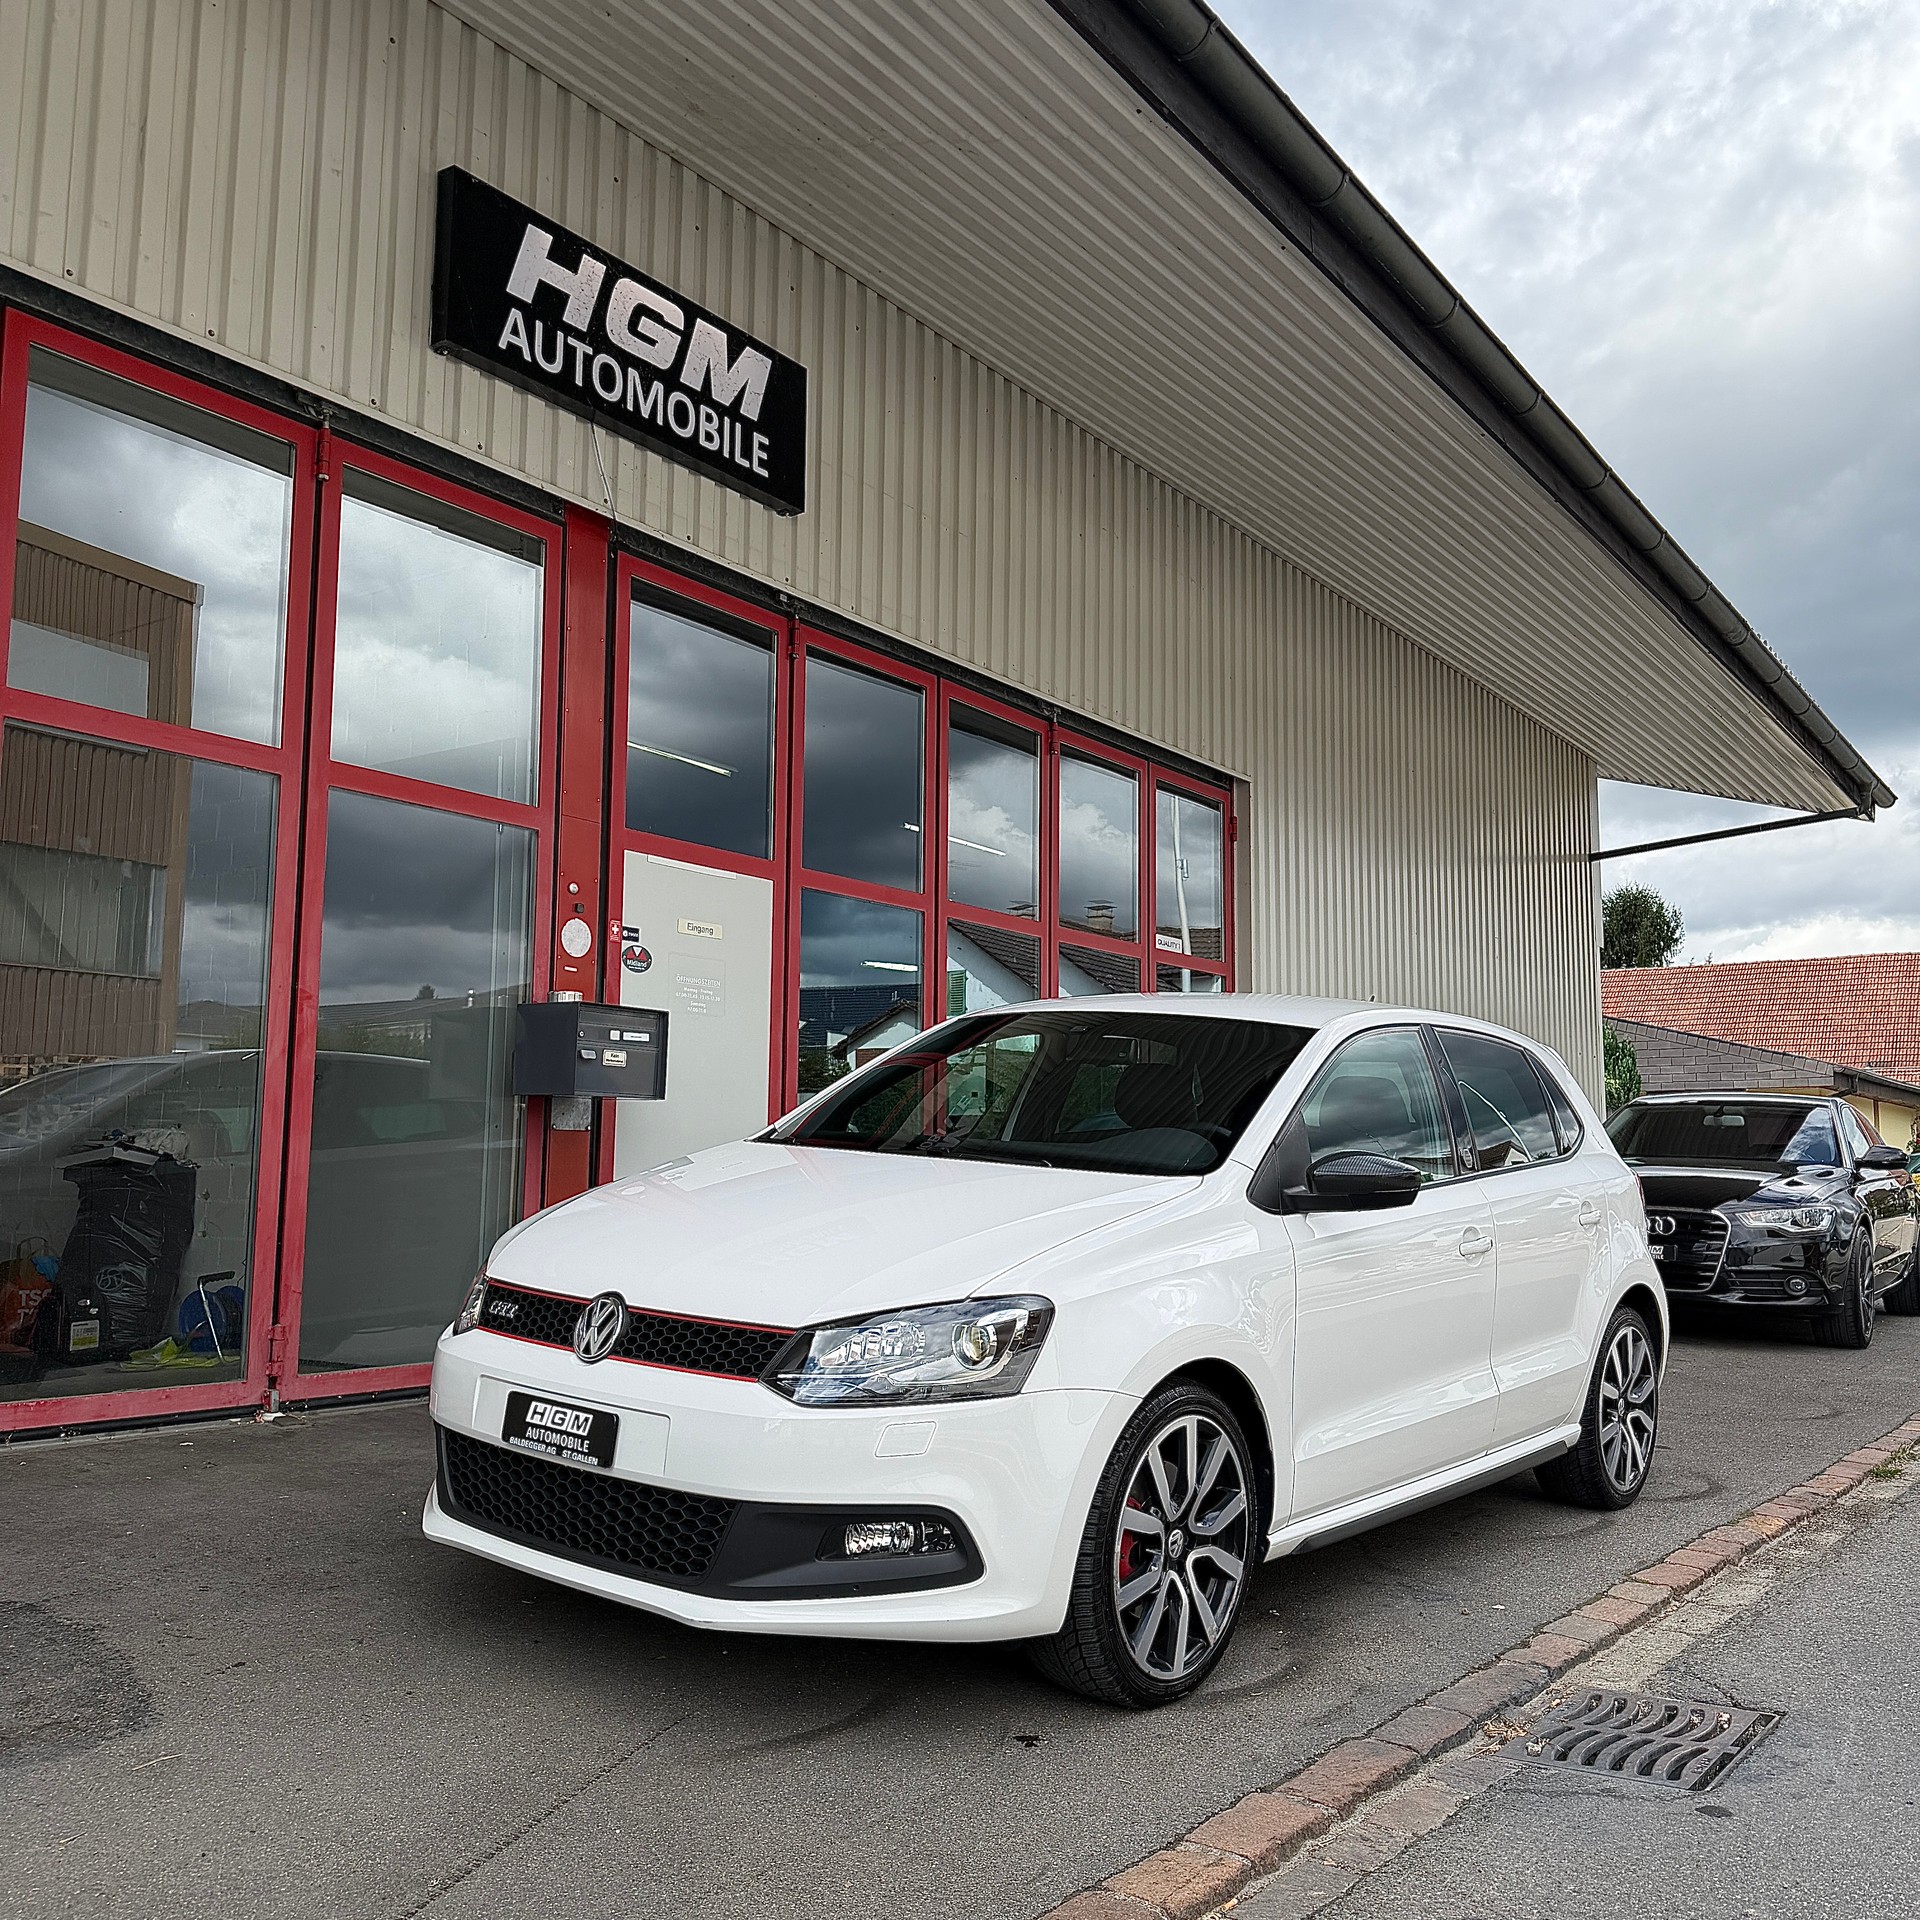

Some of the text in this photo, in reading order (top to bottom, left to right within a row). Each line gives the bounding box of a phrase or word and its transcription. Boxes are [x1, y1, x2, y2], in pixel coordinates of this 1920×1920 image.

[506, 223, 772, 421] HGM
[499, 308, 769, 478] AUTOMOBILE
[687, 922, 714, 936] Eingang
[626, 959, 648, 968] Midland
[527, 1401, 593, 1436] HGM
[509, 1436, 546, 1452] BALDEGGER
[546, 1445, 557, 1455] AG
[526, 1426, 590, 1453] AUTOMOBILE
